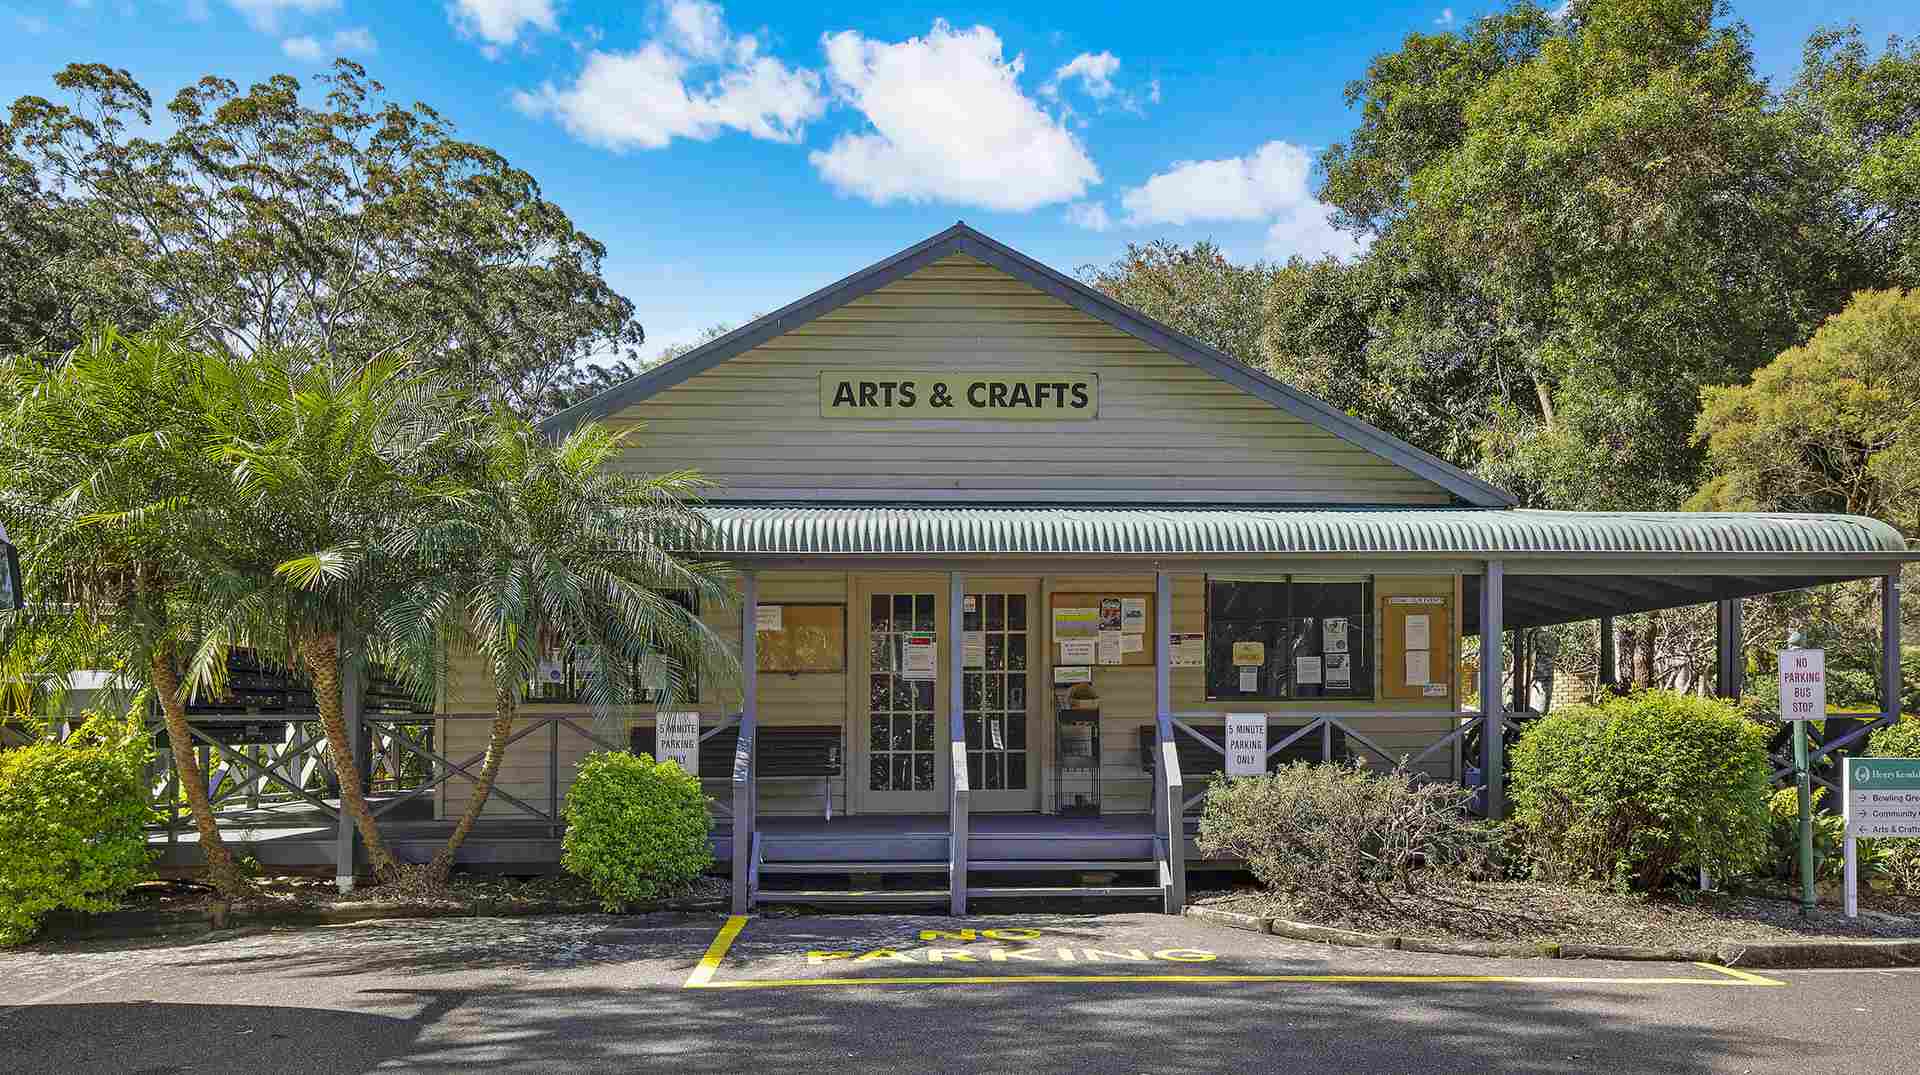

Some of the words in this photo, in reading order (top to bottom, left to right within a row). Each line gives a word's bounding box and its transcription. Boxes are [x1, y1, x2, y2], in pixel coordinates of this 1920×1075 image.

[832, 381, 917, 408] ARTS
[928, 382, 953, 408] &
[966, 382, 1089, 408] CRAFTS
[1796, 657, 1808, 668] NO
[1784, 672, 1821, 683] PARKING
[1794, 687, 1812, 698] BUS
[1792, 702, 1814, 713] STOP
[658, 724, 665, 734] 5
[665, 723, 697, 734] MINUTE
[1228, 724, 1234, 734] 5
[1236, 724, 1264, 734] MINUTE
[661, 739, 697, 749] PARKING
[1231, 739, 1262, 750] PARKING
[1236, 754, 1256, 765] ONLY
[1872, 793, 1903, 803] Bowling
[1905, 793, 1920, 802] Gre
[1872, 810, 1917, 819] Community
[1872, 825, 1889, 833] Arts
[1890, 825, 1897, 833] &
[919, 928, 1041, 941] NO
[806, 947, 1217, 963] PARKING
